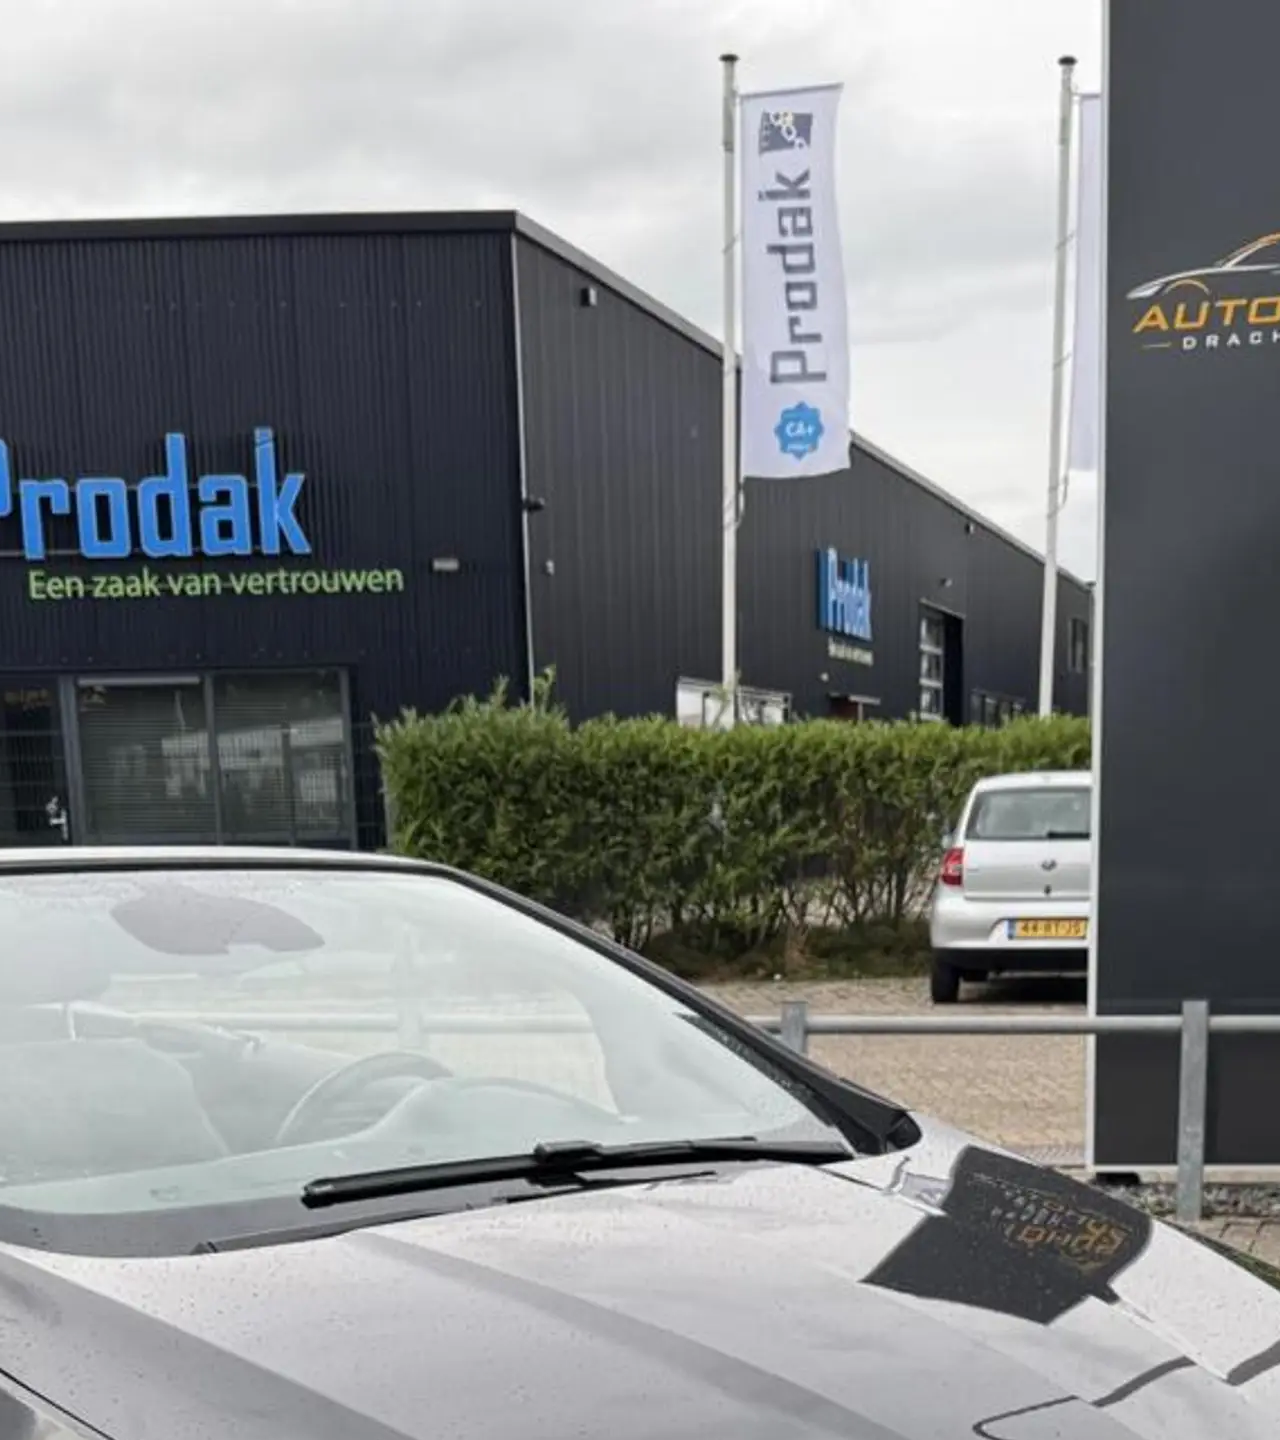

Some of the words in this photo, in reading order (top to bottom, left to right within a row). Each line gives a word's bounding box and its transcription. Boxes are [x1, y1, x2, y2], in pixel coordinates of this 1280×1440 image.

[757, 168, 827, 384] Prodak
[28, 568, 85, 600] Een
[92, 565, 161, 598] zaak
[167, 571, 222, 597] van
[228, 567, 405, 596] vertrouwen
